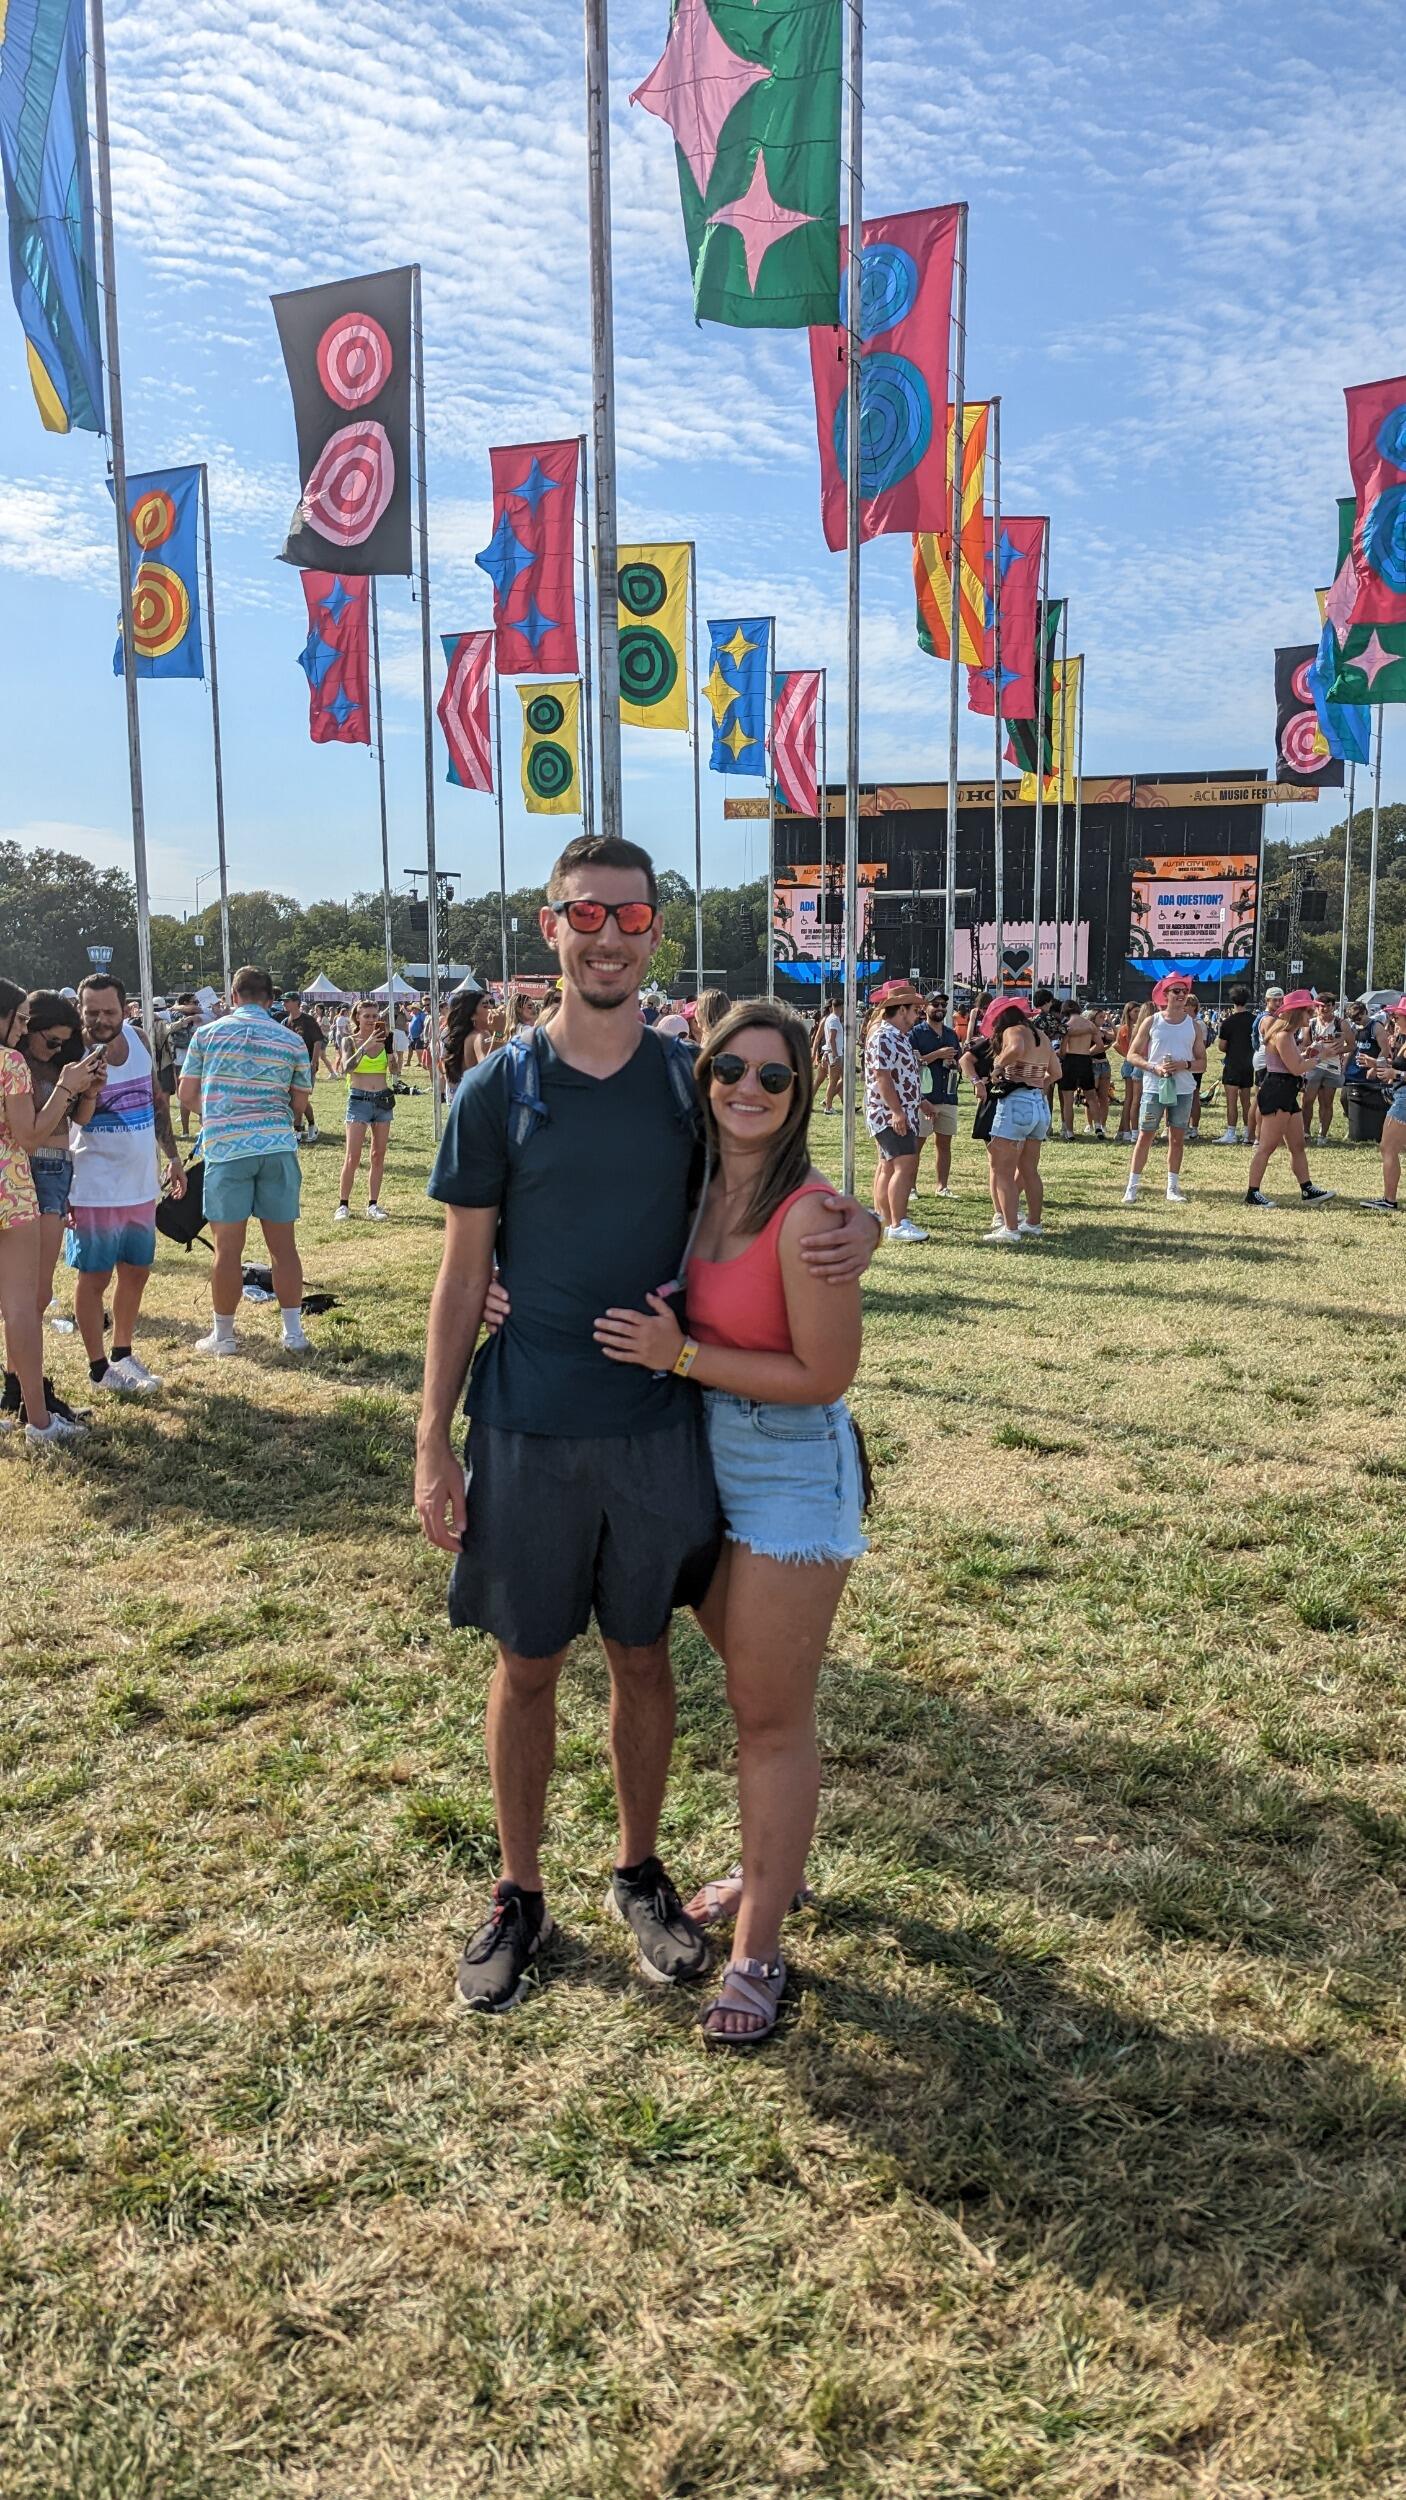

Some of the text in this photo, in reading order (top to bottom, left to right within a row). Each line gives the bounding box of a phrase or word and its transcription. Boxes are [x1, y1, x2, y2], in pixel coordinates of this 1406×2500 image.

[966, 790, 1017, 802] HON
[1193, 788, 1272, 802] ACL MUSIC FEST
[1157, 895, 1223, 906] ADA QUESTION?
[800, 902, 815, 911] ADA
